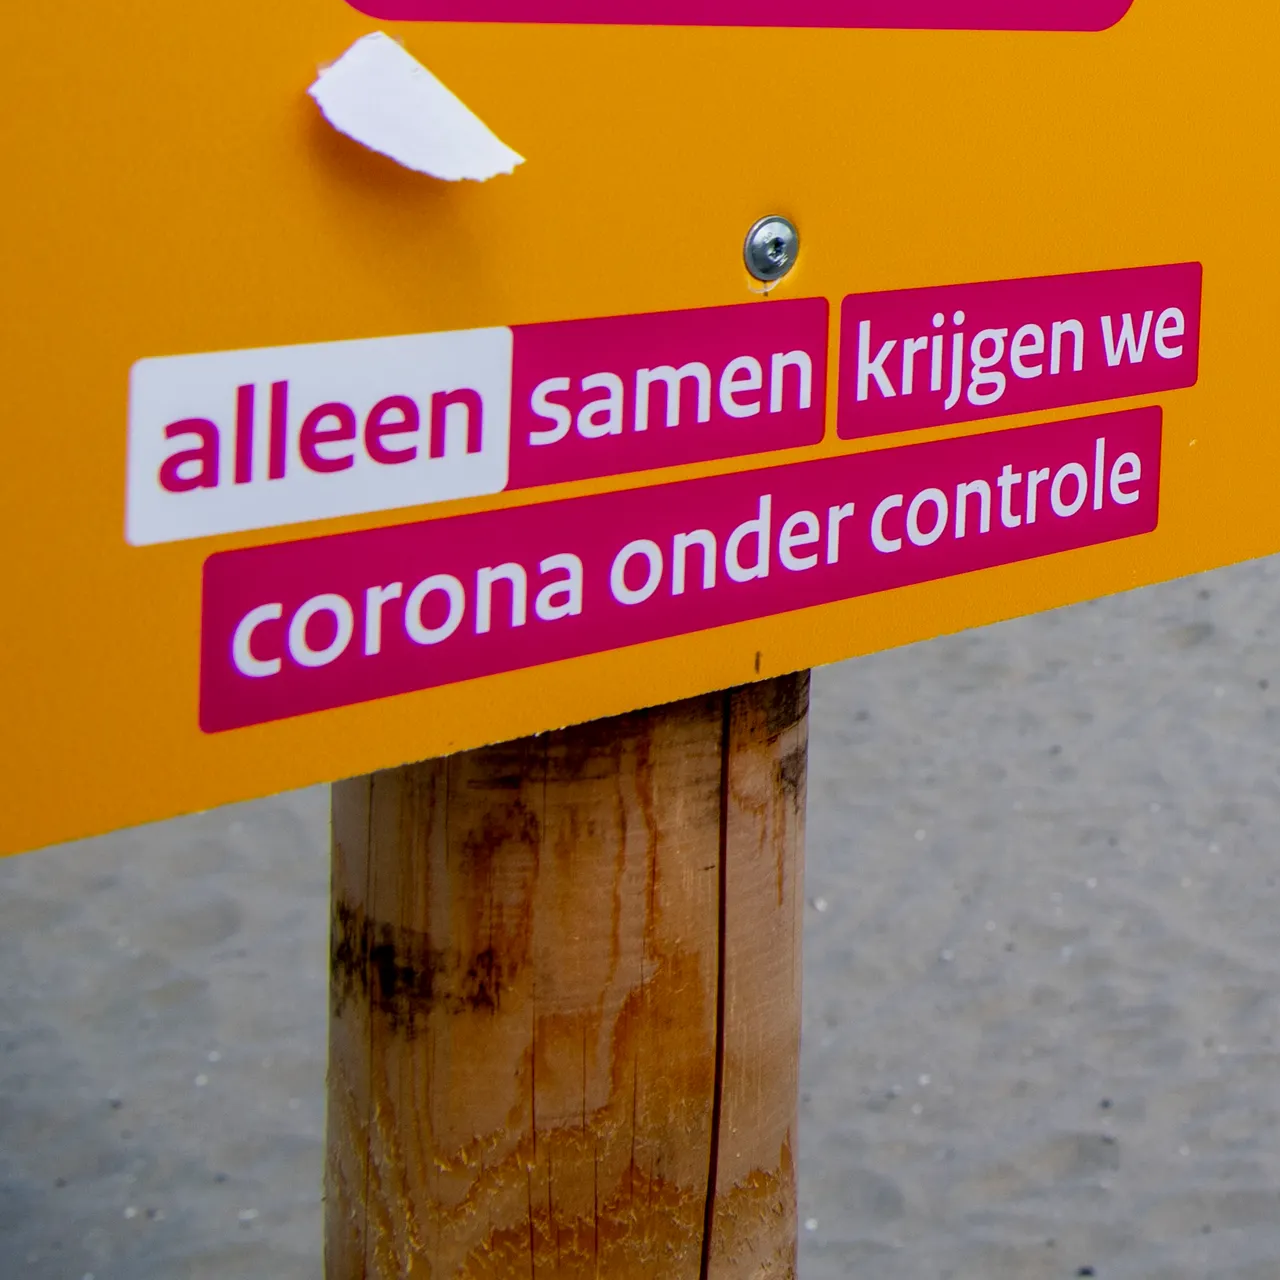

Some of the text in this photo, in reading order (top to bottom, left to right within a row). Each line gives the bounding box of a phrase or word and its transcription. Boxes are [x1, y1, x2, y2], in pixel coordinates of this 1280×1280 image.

[157, 303, 1185, 493] alleen samen krijgen we
[231, 435, 1141, 679] corona onder controle
